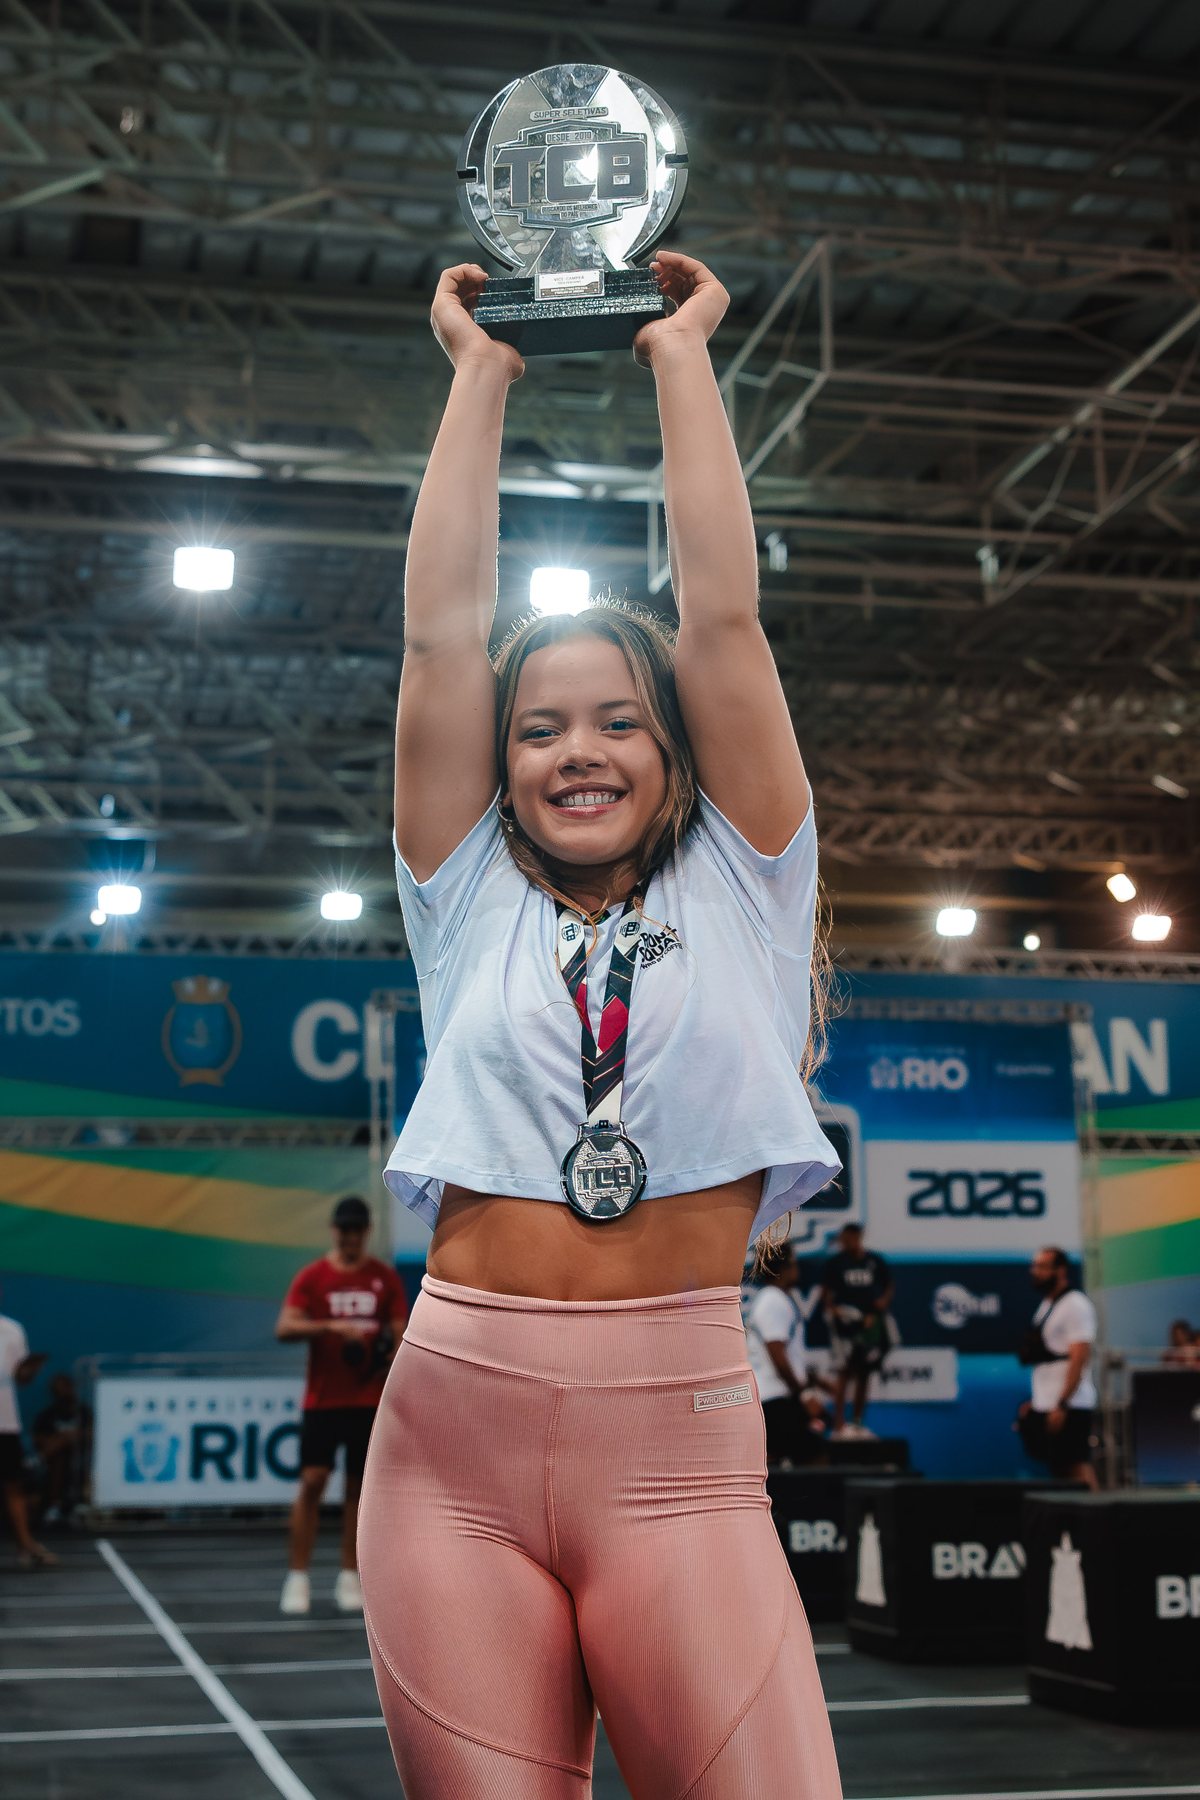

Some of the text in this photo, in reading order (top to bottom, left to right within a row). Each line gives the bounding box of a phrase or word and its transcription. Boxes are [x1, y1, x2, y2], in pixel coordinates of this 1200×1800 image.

[533, 107, 607, 119] SUPER SELETIVAS
[494, 140, 648, 206] TCB
[564, 922, 576, 942] TCB
[901, 1057, 969, 1090] RIO
[576, 1165, 633, 1191] TCB
[908, 1170, 1046, 1217] 2026
[788, 1519, 849, 1552] BR
